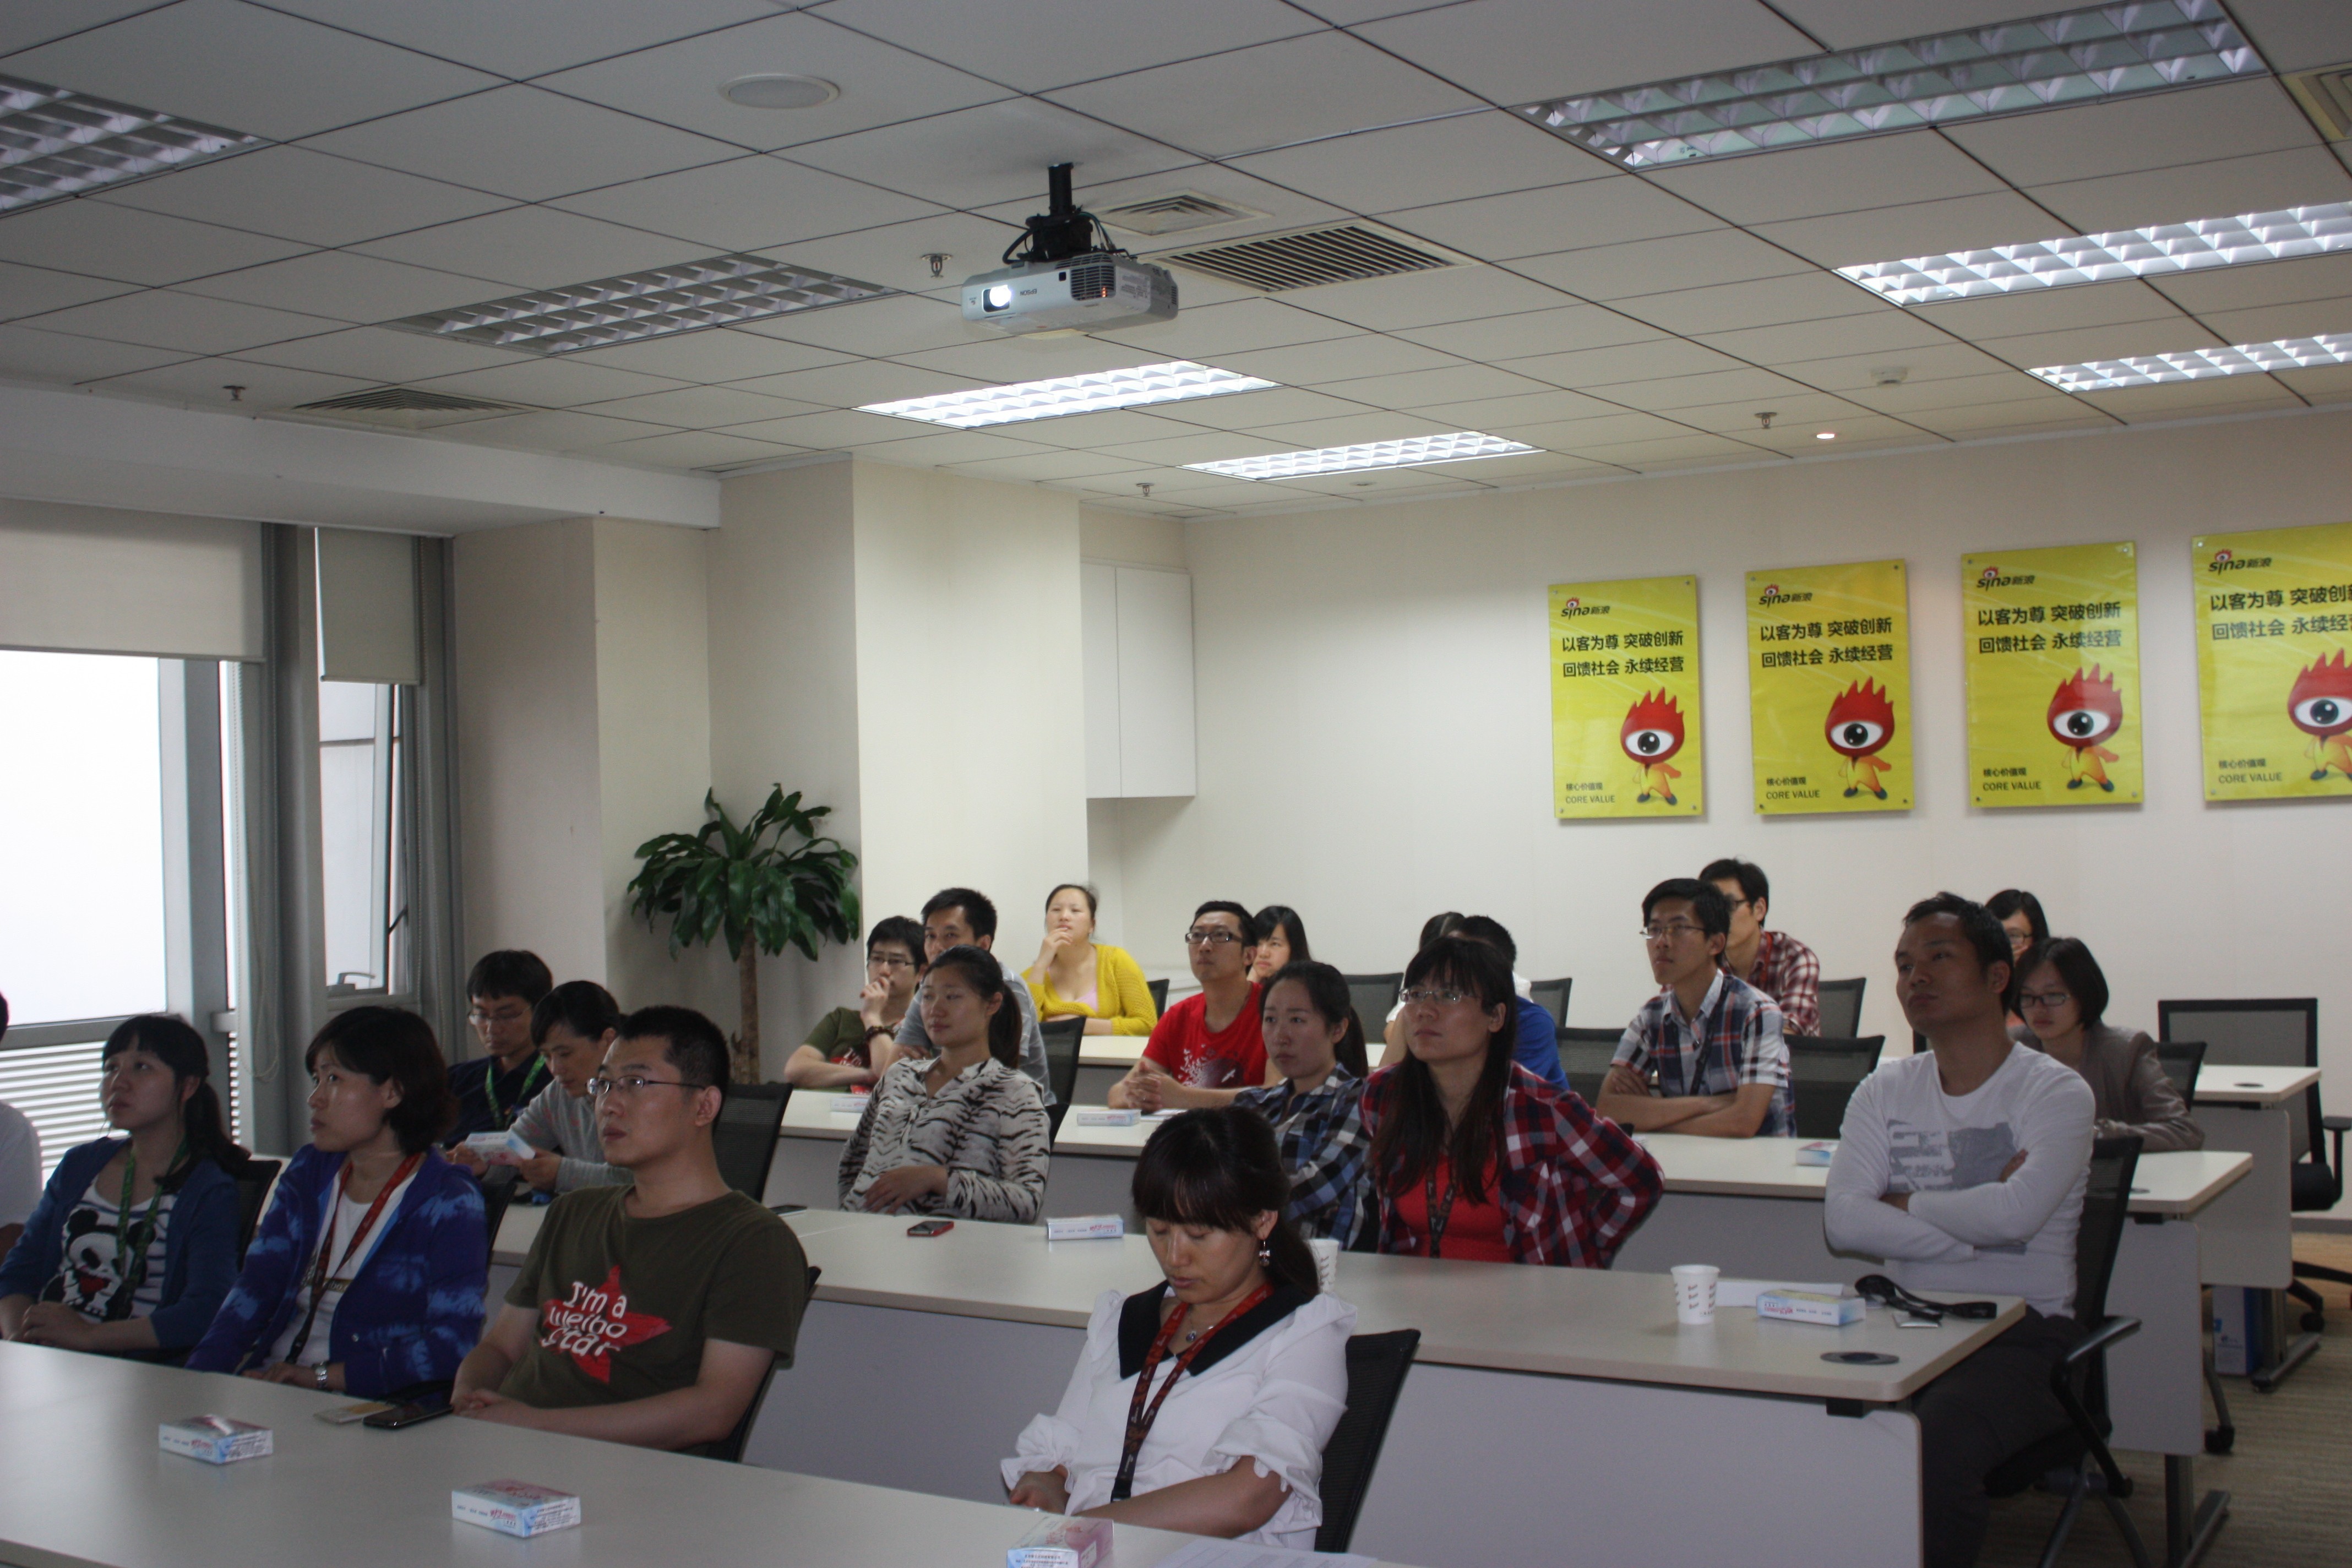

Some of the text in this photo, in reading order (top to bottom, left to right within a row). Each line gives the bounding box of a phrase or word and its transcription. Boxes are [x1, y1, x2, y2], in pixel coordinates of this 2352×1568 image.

[2211, 590, 2284, 611] 以客为尊
[1978, 601, 2121, 625] 以客为尊 突破创新
[1760, 617, 1891, 641] 以客为尊 突破创新
[2212, 619, 2284, 640] 回馈社会
[1562, 630, 1684, 652] 以客为尊 突破创新
[1979, 630, 2121, 654] 回馈社会 永续经营
[1563, 656, 1684, 677] 回馈社会 永续经营
[1762, 644, 1893, 668] 回馈社会 永续经营
[1983, 781, 2041, 791] CORE VALUE
[2219, 772, 2282, 784] CORE VALUE
[1766, 790, 1820, 799] CORE VALUE
[563, 1281, 627, 1319] I'm a
